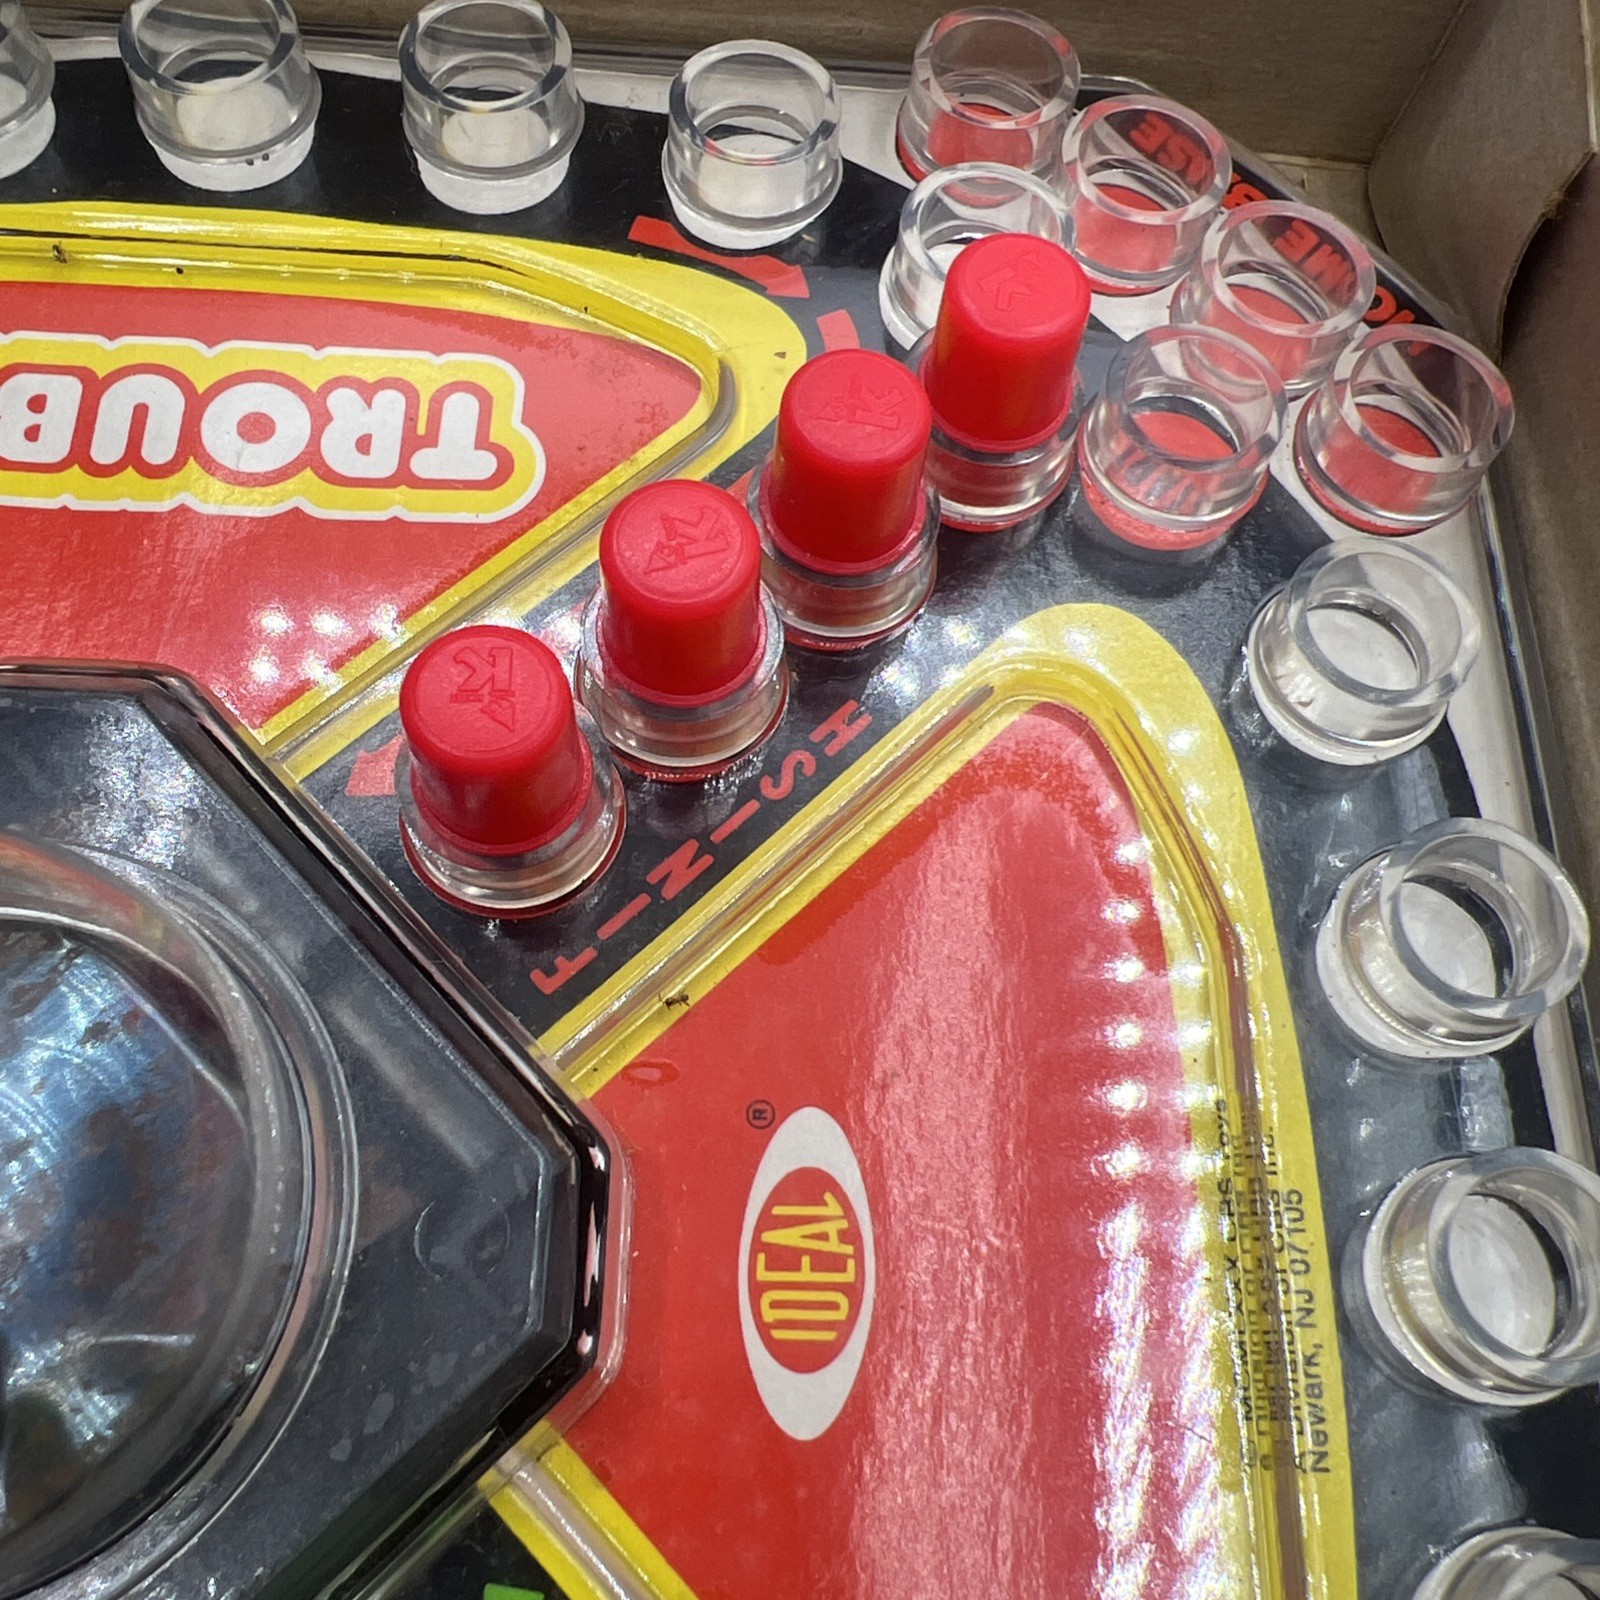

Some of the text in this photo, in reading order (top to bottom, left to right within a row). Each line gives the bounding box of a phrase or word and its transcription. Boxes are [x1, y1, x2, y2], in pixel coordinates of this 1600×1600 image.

[0, 373, 498, 481] TROUB
[529, 699, 873, 995] FINISH
[756, 1191, 856, 1341] IDEAL
[1283, 1188, 1331, 1474] Newark, NJ 07105
